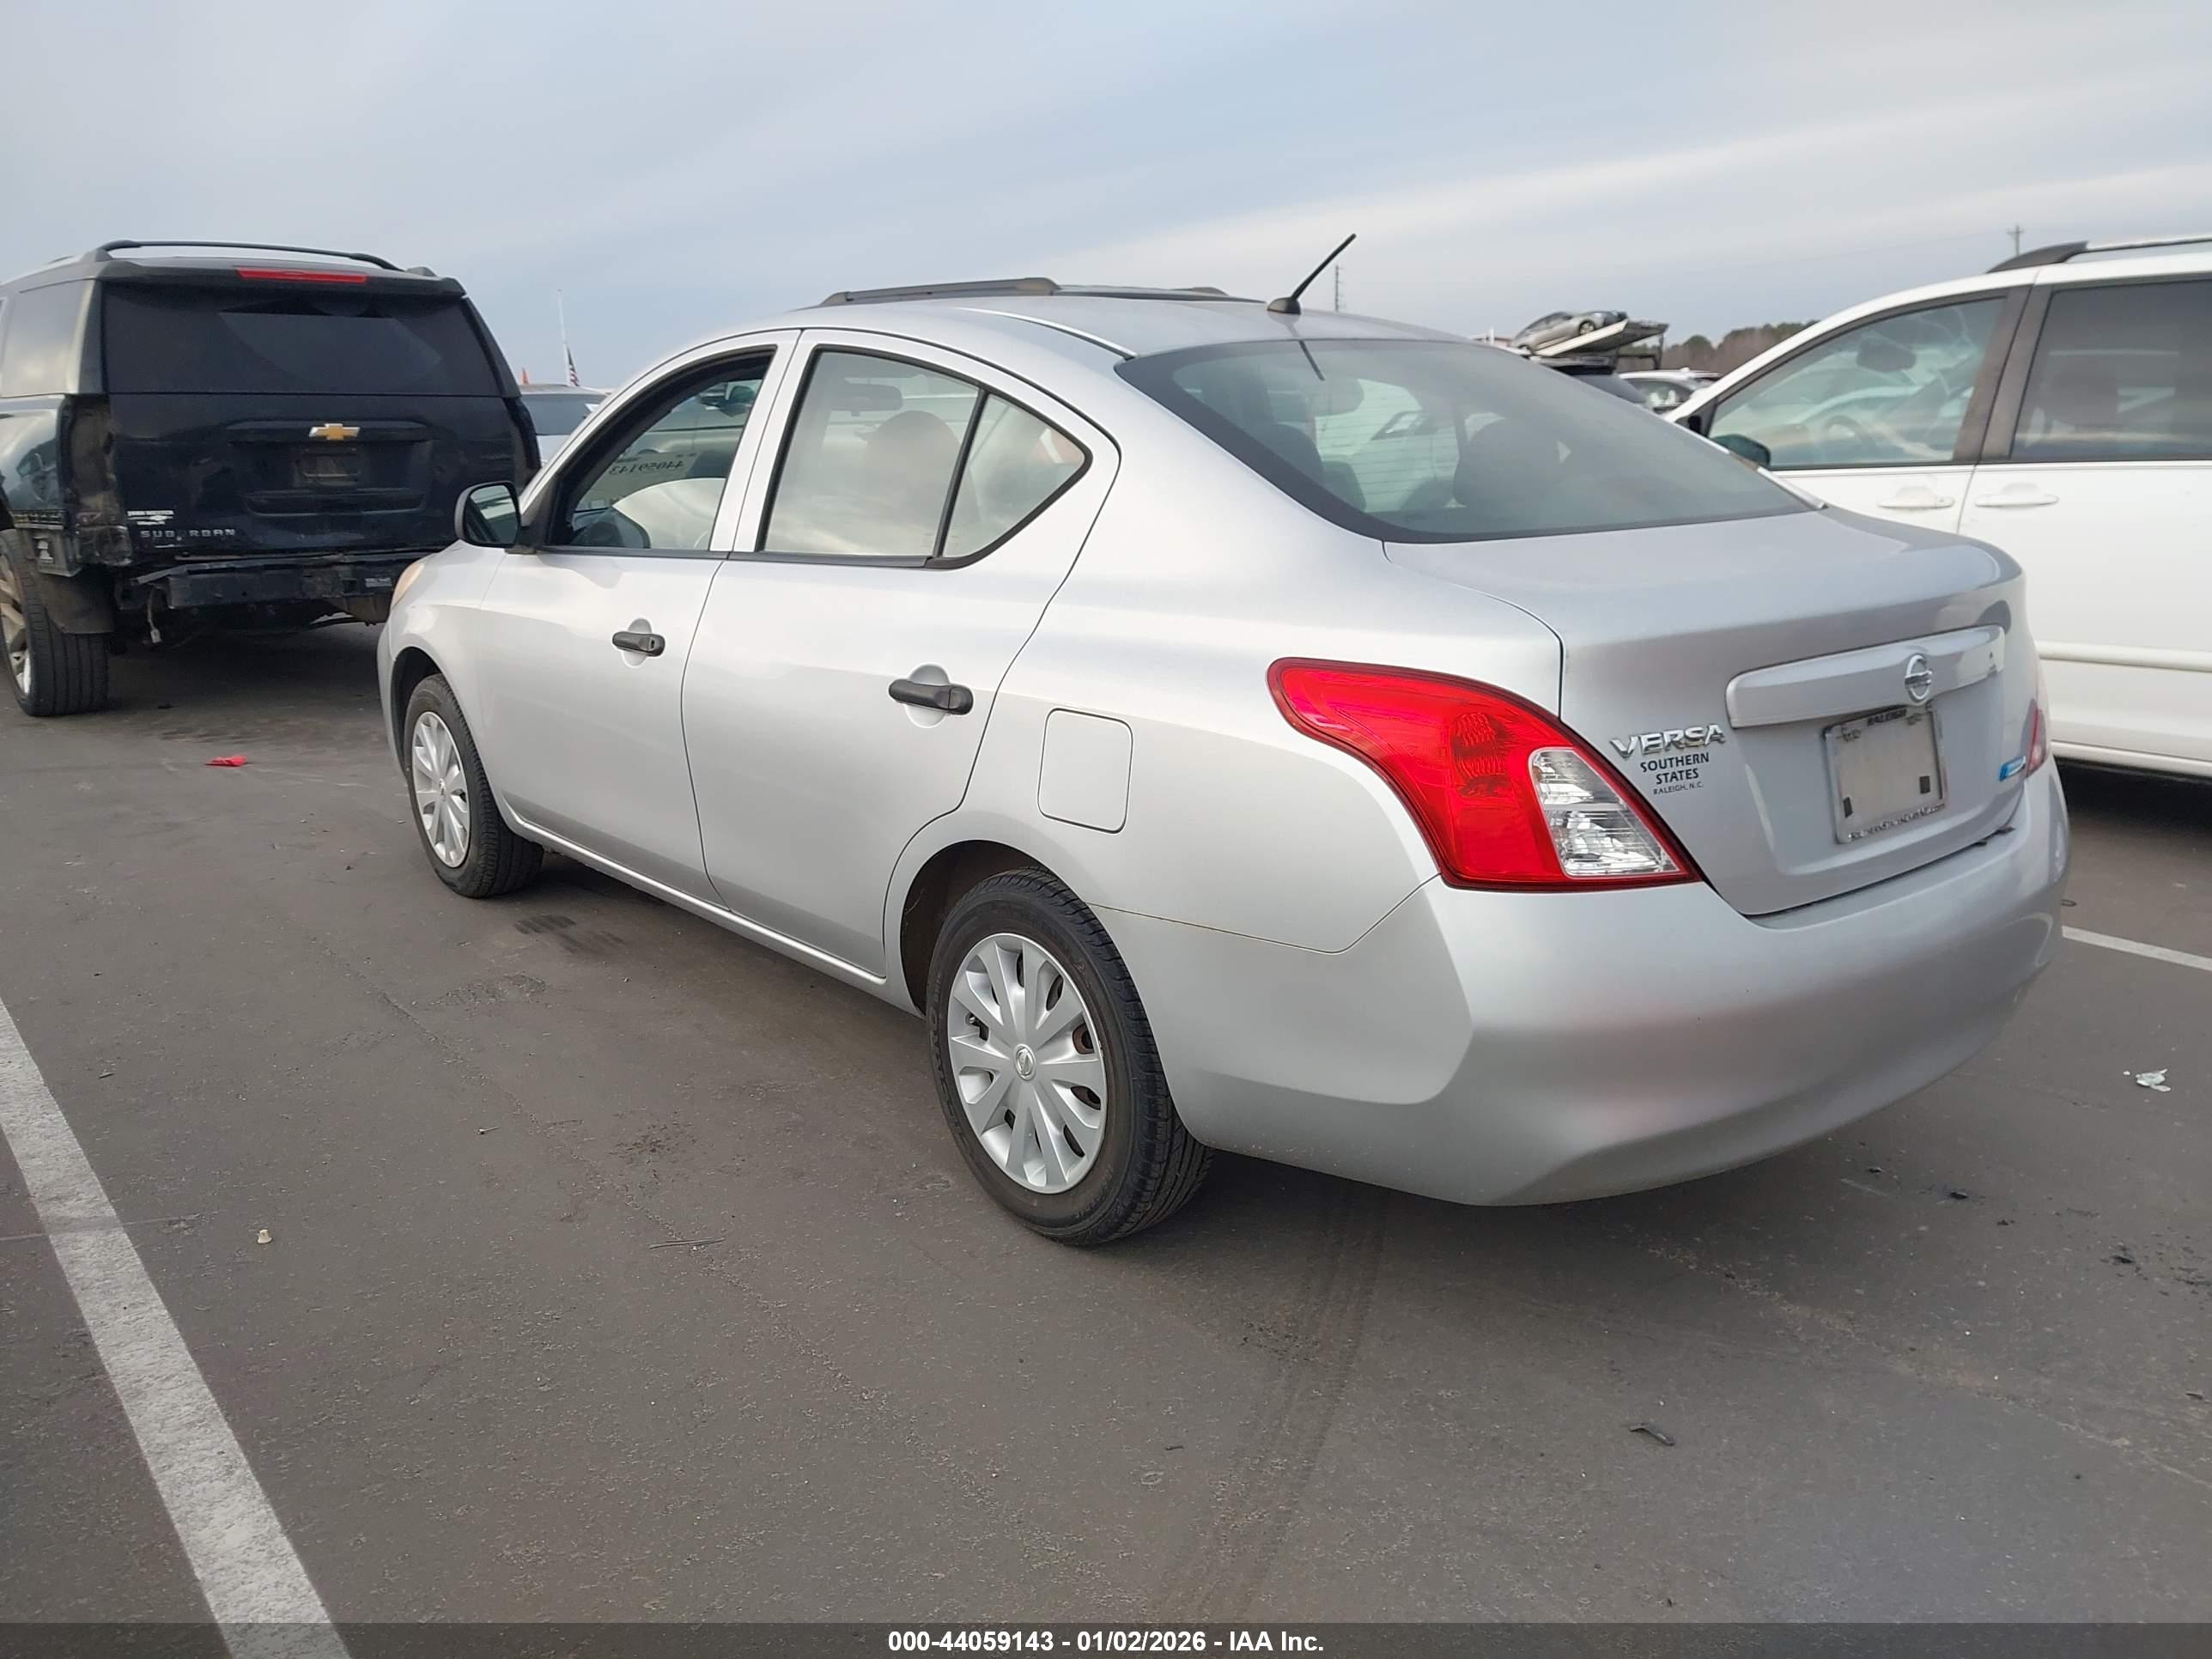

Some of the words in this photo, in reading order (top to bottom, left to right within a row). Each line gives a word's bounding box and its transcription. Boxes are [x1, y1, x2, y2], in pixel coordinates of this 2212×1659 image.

[1609, 723, 1725, 759] VERSA
[1640, 752, 1710, 773] SOUTHERN
[1656, 768, 1699, 785] STATES
